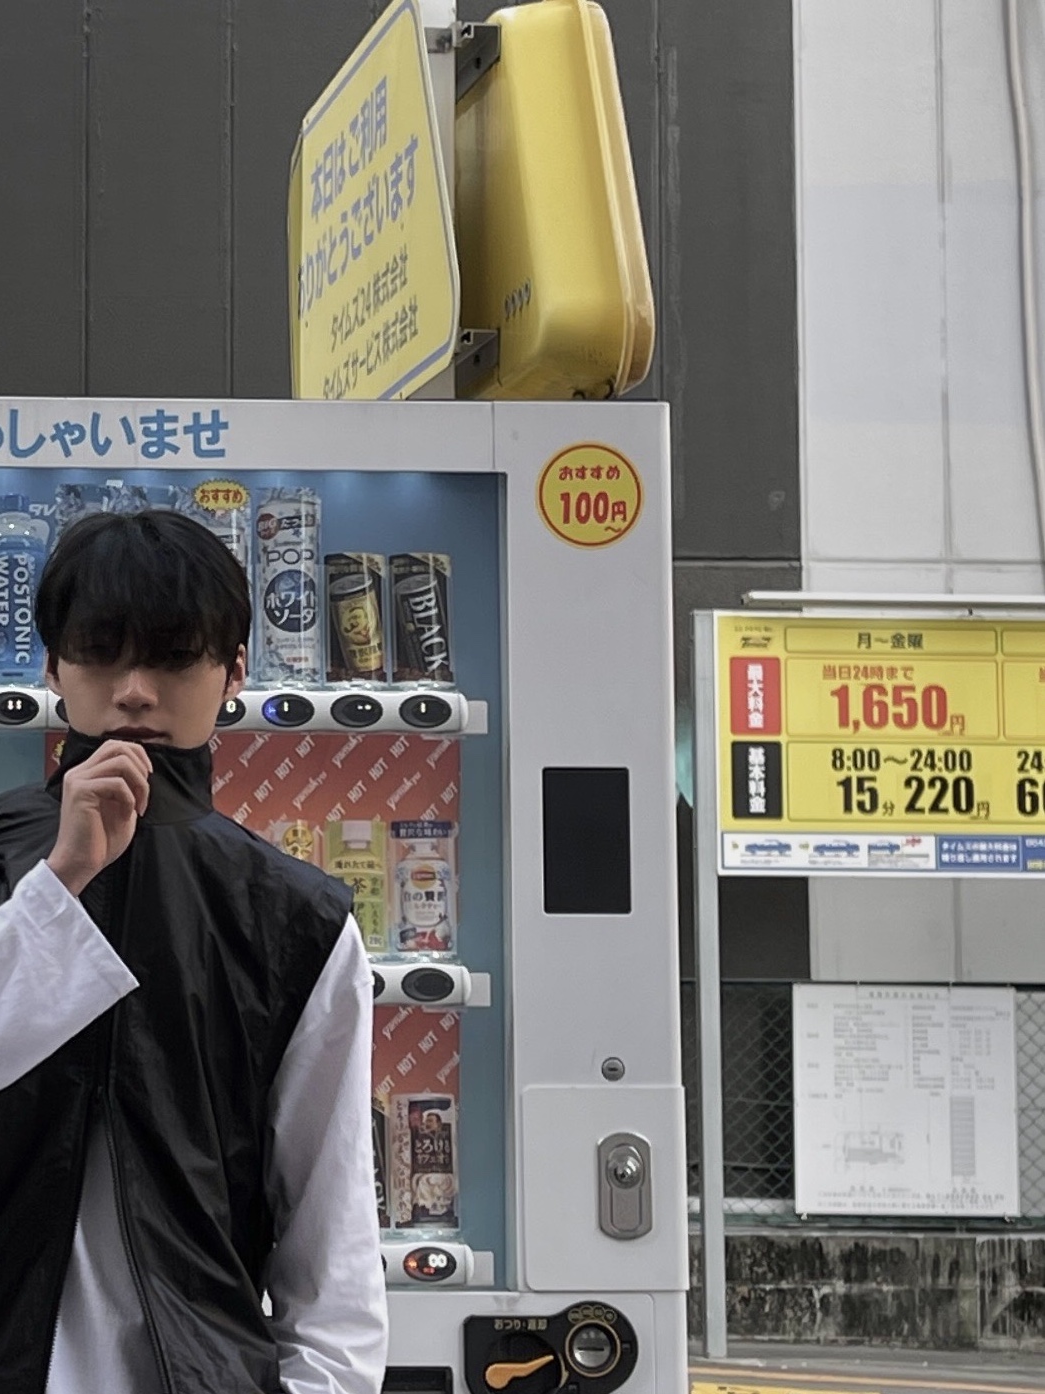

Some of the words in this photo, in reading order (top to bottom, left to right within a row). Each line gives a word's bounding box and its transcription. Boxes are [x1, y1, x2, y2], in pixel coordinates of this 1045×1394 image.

[311, 75, 387, 223] 本日はご利用
[559, 465, 621, 481] おすすめ
[200, 488, 243, 504] おすすめ
[13, 553, 33, 664] POSTONIC
[409, 592, 450, 676] BLACK
[389, 735, 410, 758] HOT
[274, 756, 295, 780] HOT
[368, 757, 389, 780] HOT
[254, 779, 274, 802] HOT
[347, 780, 367, 803] HOT
